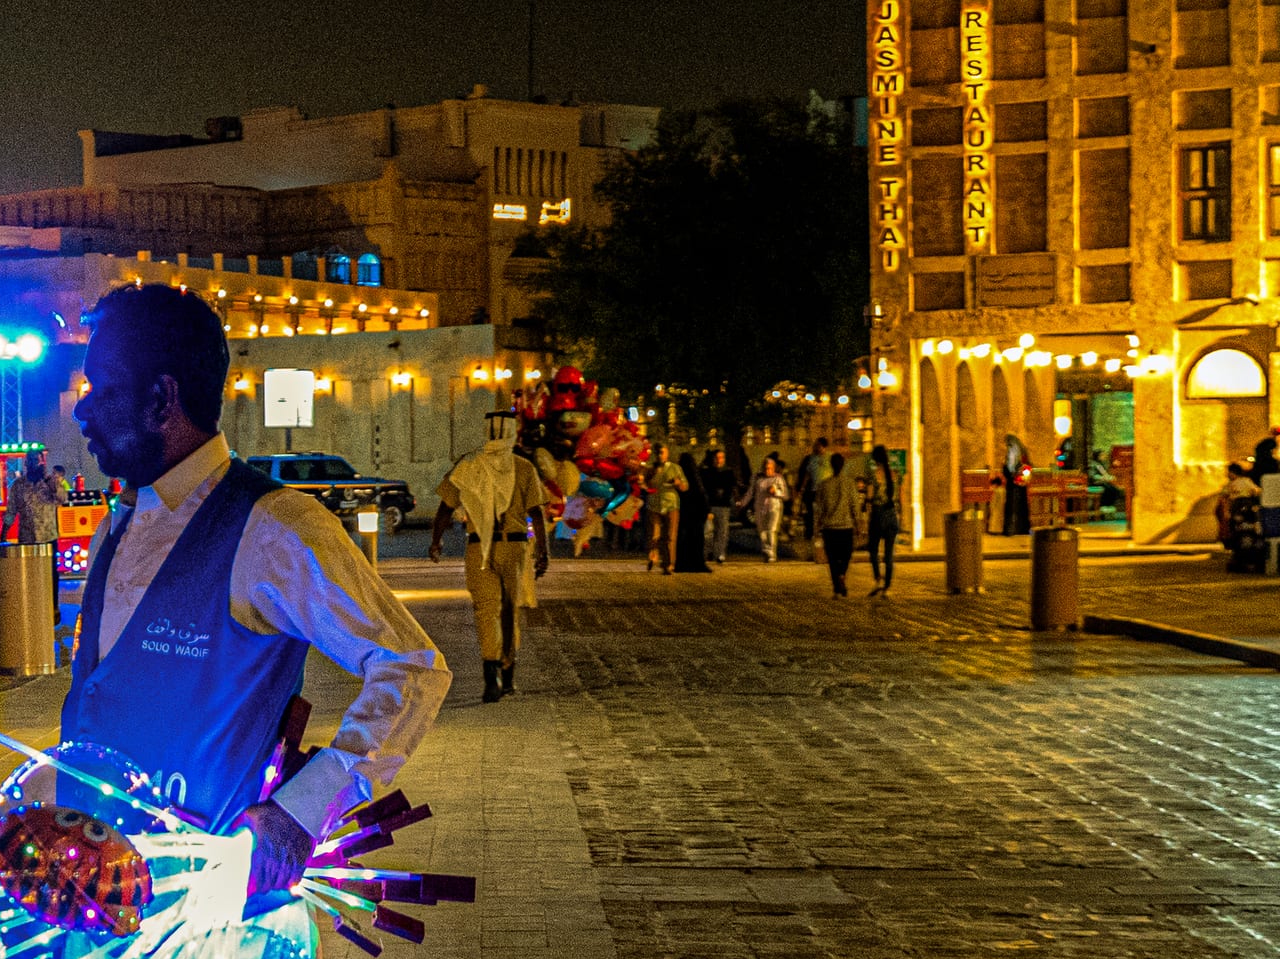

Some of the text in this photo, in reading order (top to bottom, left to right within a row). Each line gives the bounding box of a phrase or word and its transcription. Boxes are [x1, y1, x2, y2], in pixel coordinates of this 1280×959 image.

[876, 2, 898, 268] JASMINE THAI
[965, 11, 986, 243] RESTAURANT
[175, 643, 209, 657] WAQIF
